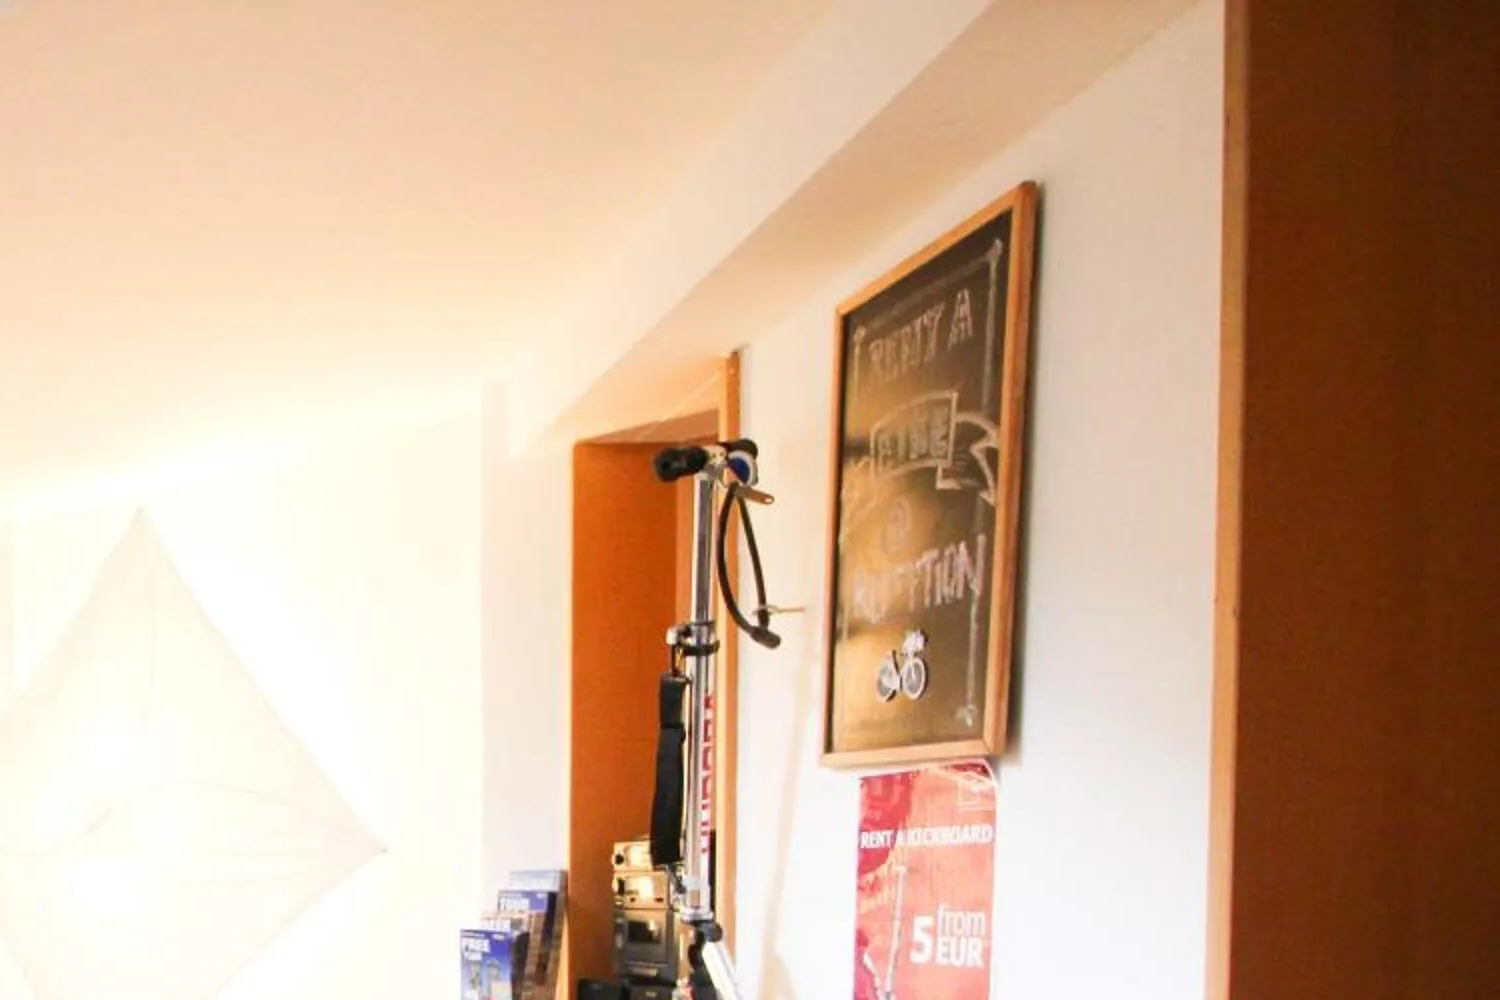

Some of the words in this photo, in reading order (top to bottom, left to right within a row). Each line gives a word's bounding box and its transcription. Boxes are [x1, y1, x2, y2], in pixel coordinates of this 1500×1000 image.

[860, 829, 892, 849] RENT
[937, 904, 986, 937] from
[910, 915, 934, 965] 5
[936, 936, 985, 969] EUR
